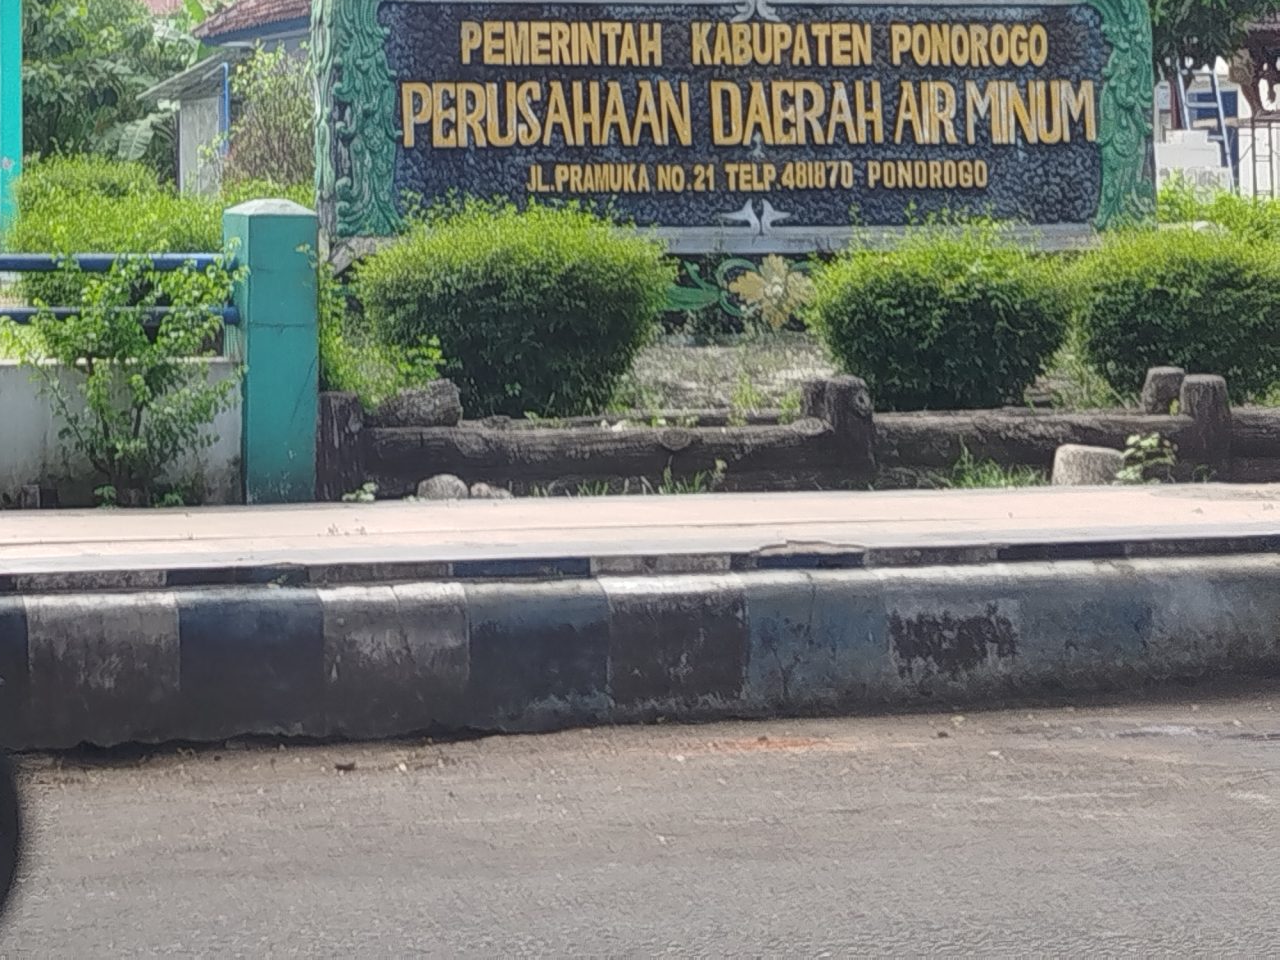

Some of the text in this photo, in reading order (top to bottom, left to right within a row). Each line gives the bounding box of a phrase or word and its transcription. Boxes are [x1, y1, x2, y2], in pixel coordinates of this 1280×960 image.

[460, 20, 1048, 68] PEMERINTAH KABUPATEN PONOROGO
[401, 79, 1098, 148] PERUSAHAAN DAERAH AIR MINUM
[867, 160, 989, 190] PONOROGO
